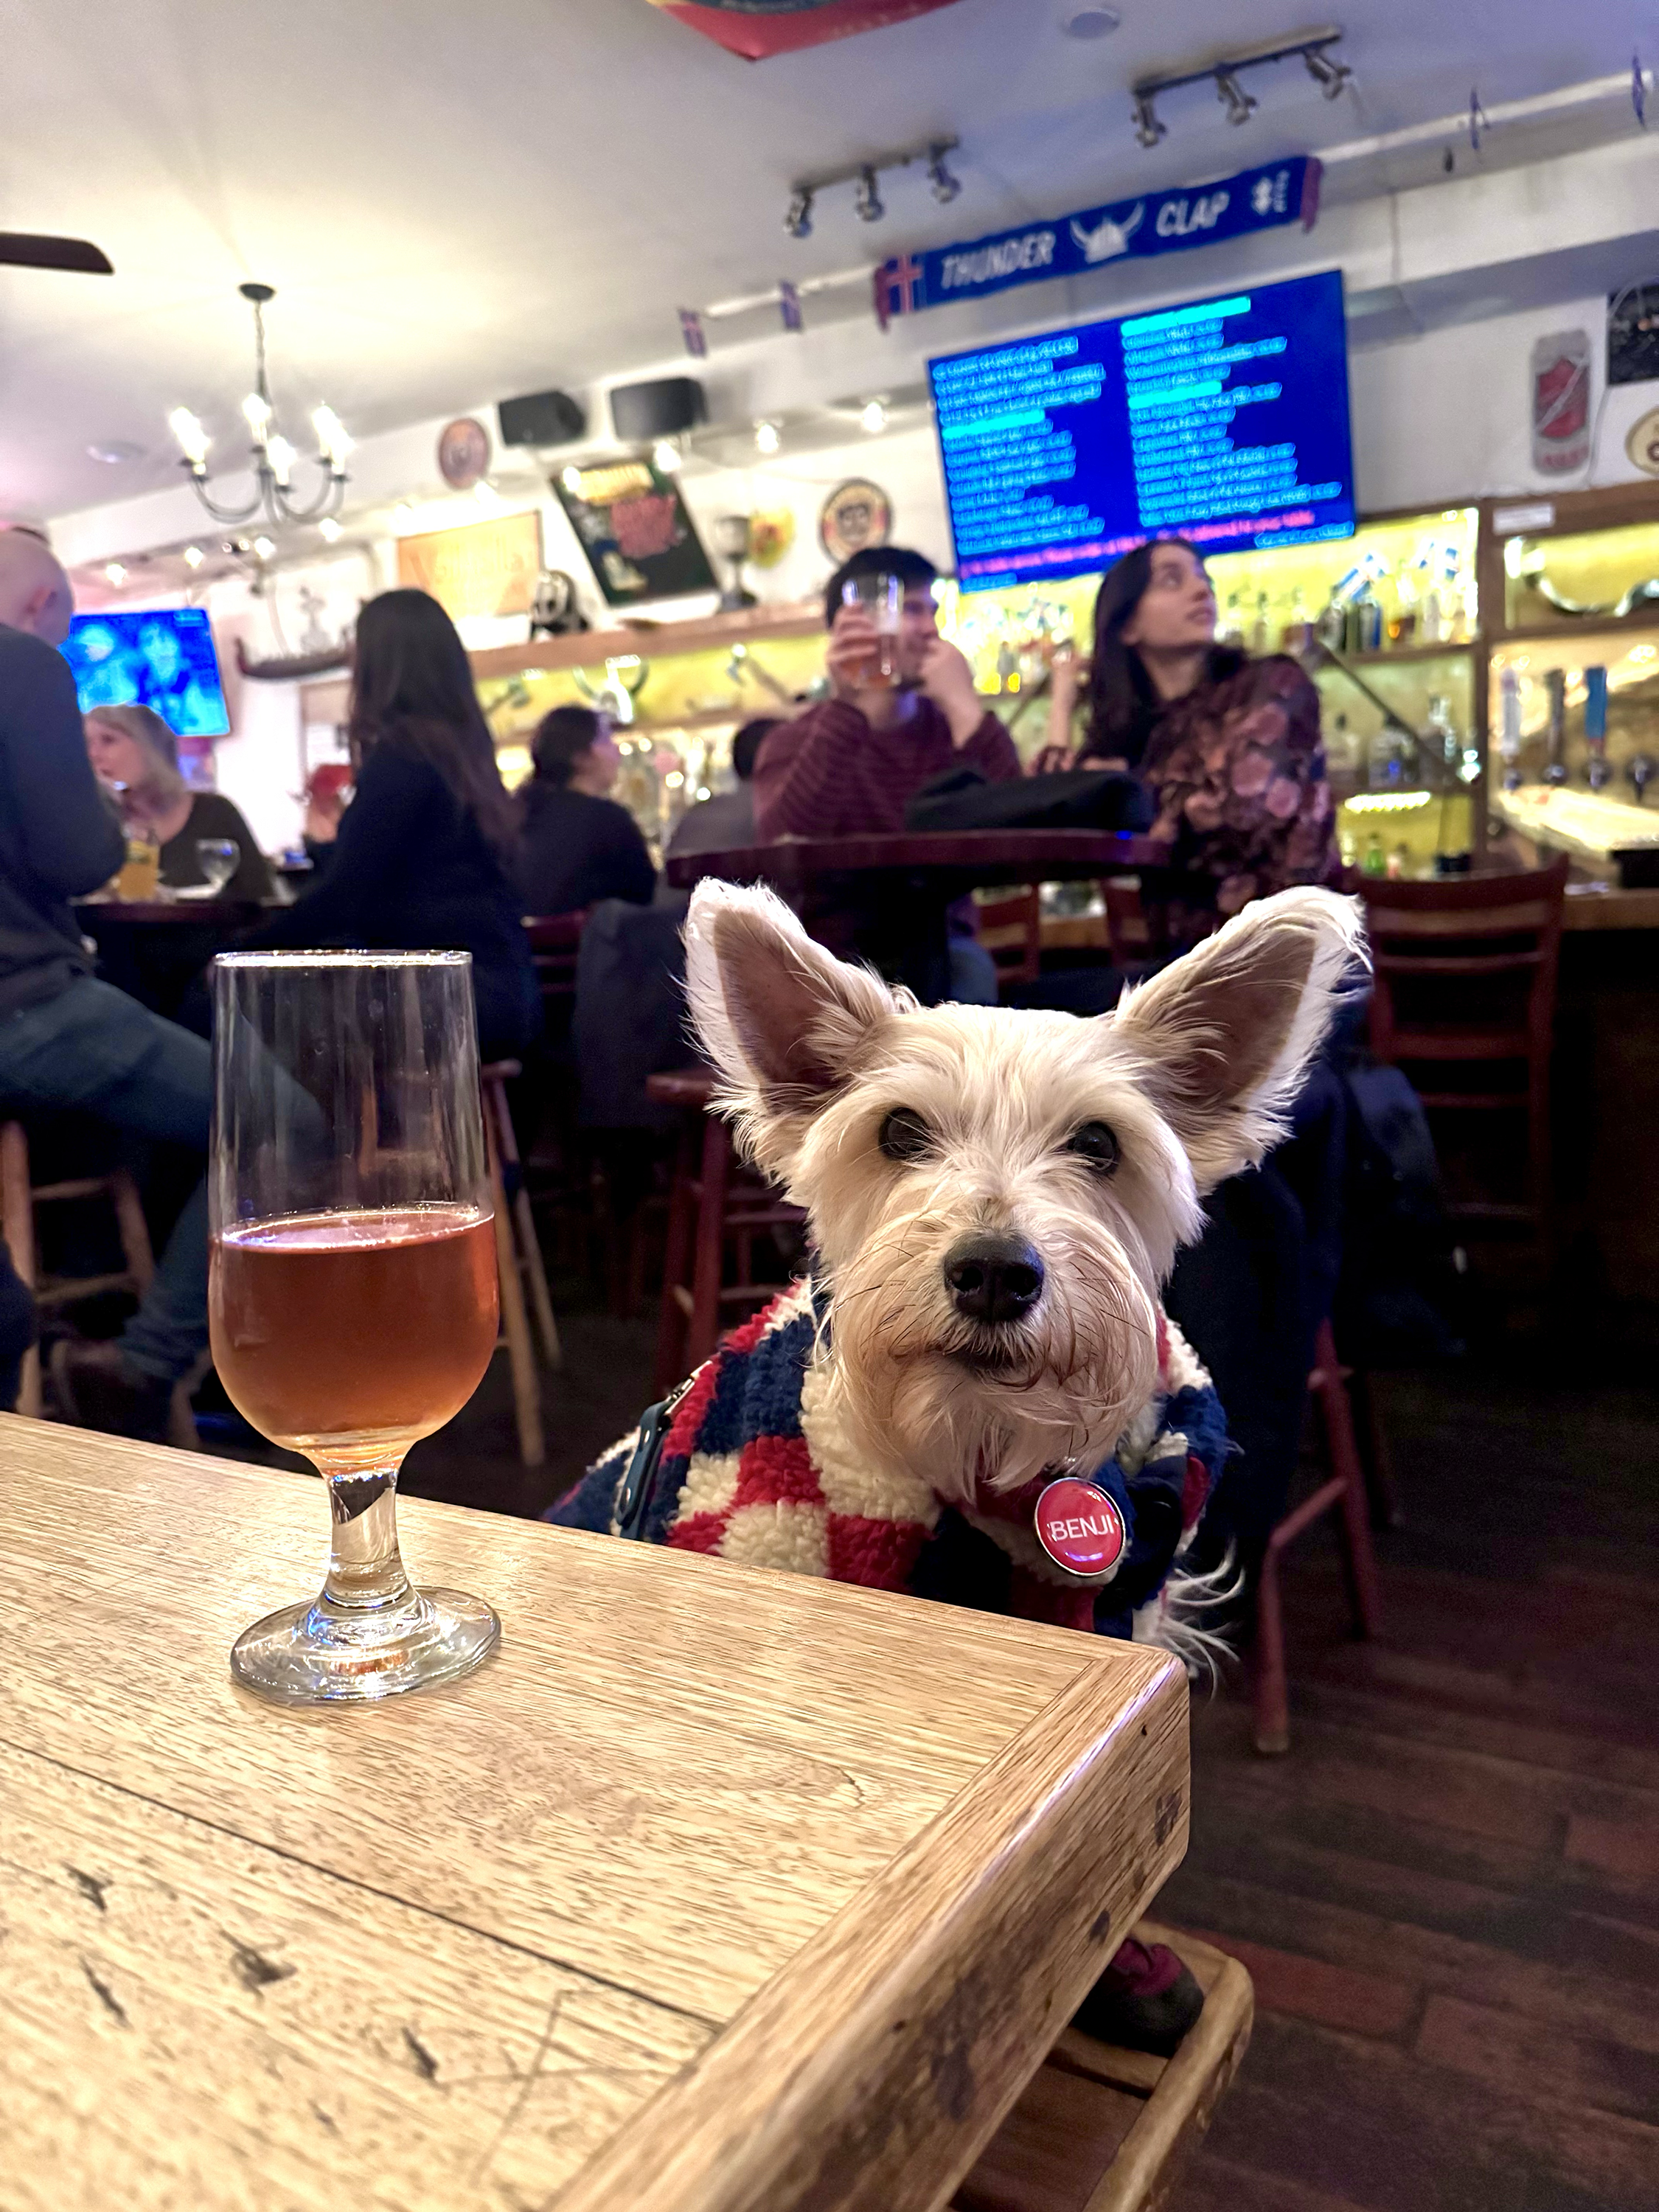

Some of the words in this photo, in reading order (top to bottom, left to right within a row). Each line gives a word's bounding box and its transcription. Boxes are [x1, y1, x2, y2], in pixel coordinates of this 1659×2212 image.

[941, 231, 1056, 289] THUNDER
[1155, 190, 1231, 237] CLAP
[1050, 1514, 1114, 1540] BENJI
